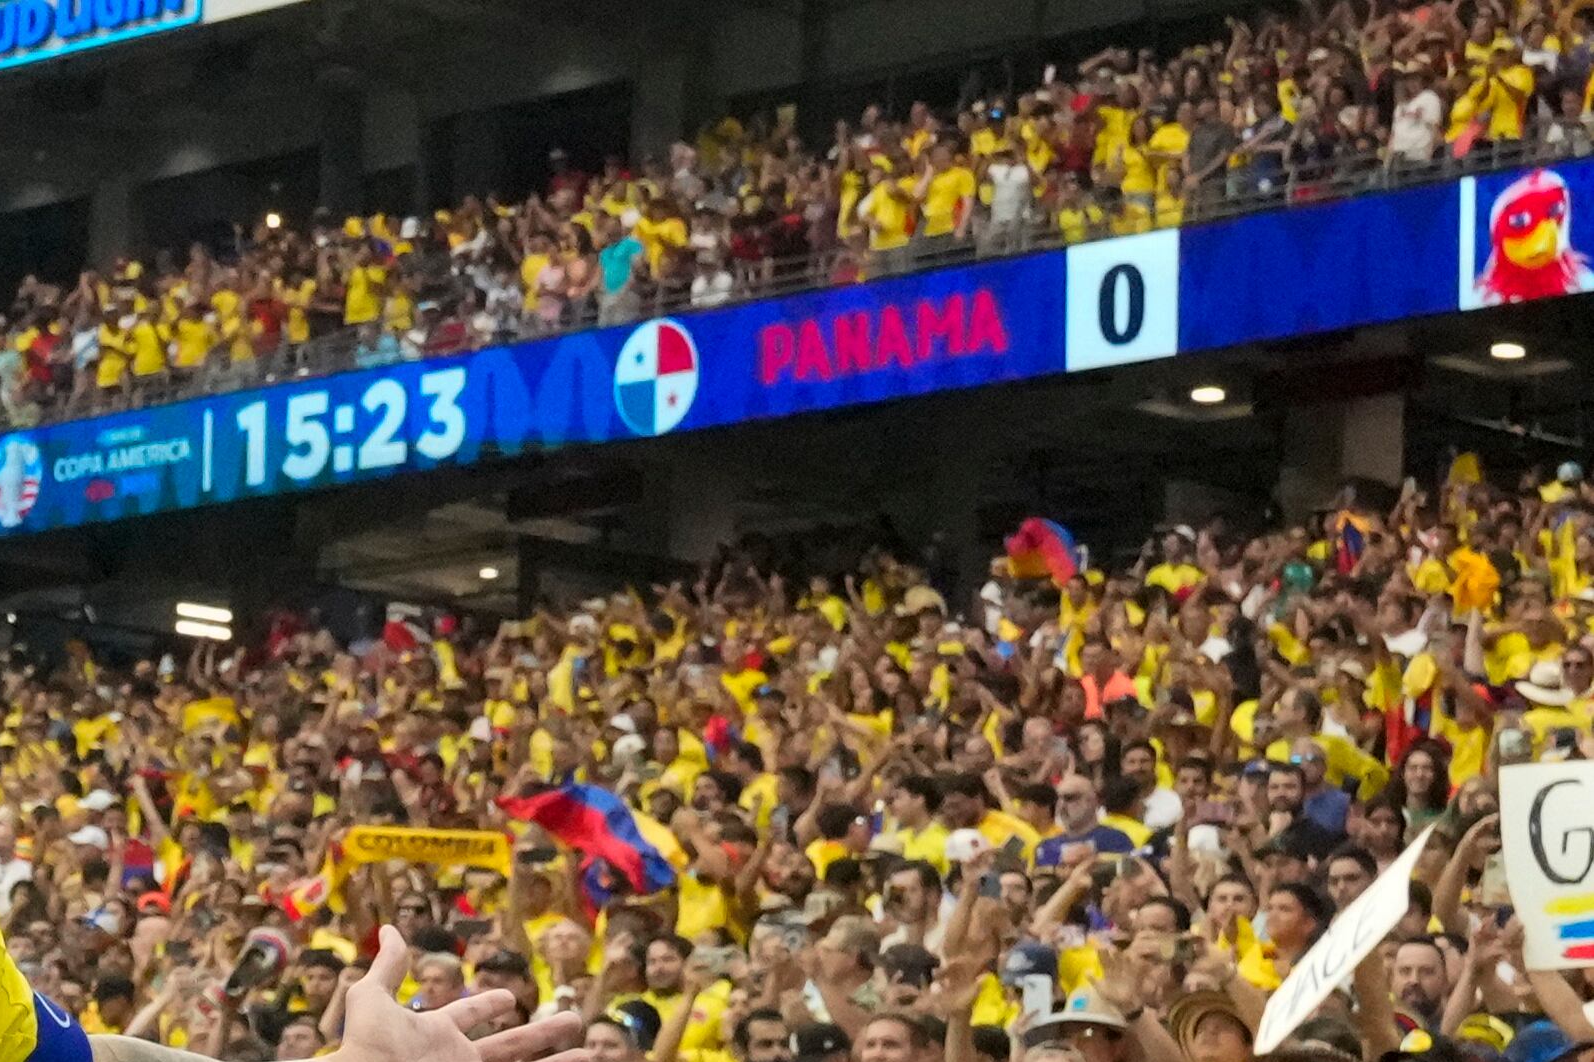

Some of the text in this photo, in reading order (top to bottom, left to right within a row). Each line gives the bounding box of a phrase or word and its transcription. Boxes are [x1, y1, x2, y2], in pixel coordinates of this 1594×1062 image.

[56, 0, 184, 38] LIG
[762, 289, 1008, 384] PANAMA
[1098, 264, 1145, 346] 0
[236, 367, 466, 486] 15:23
